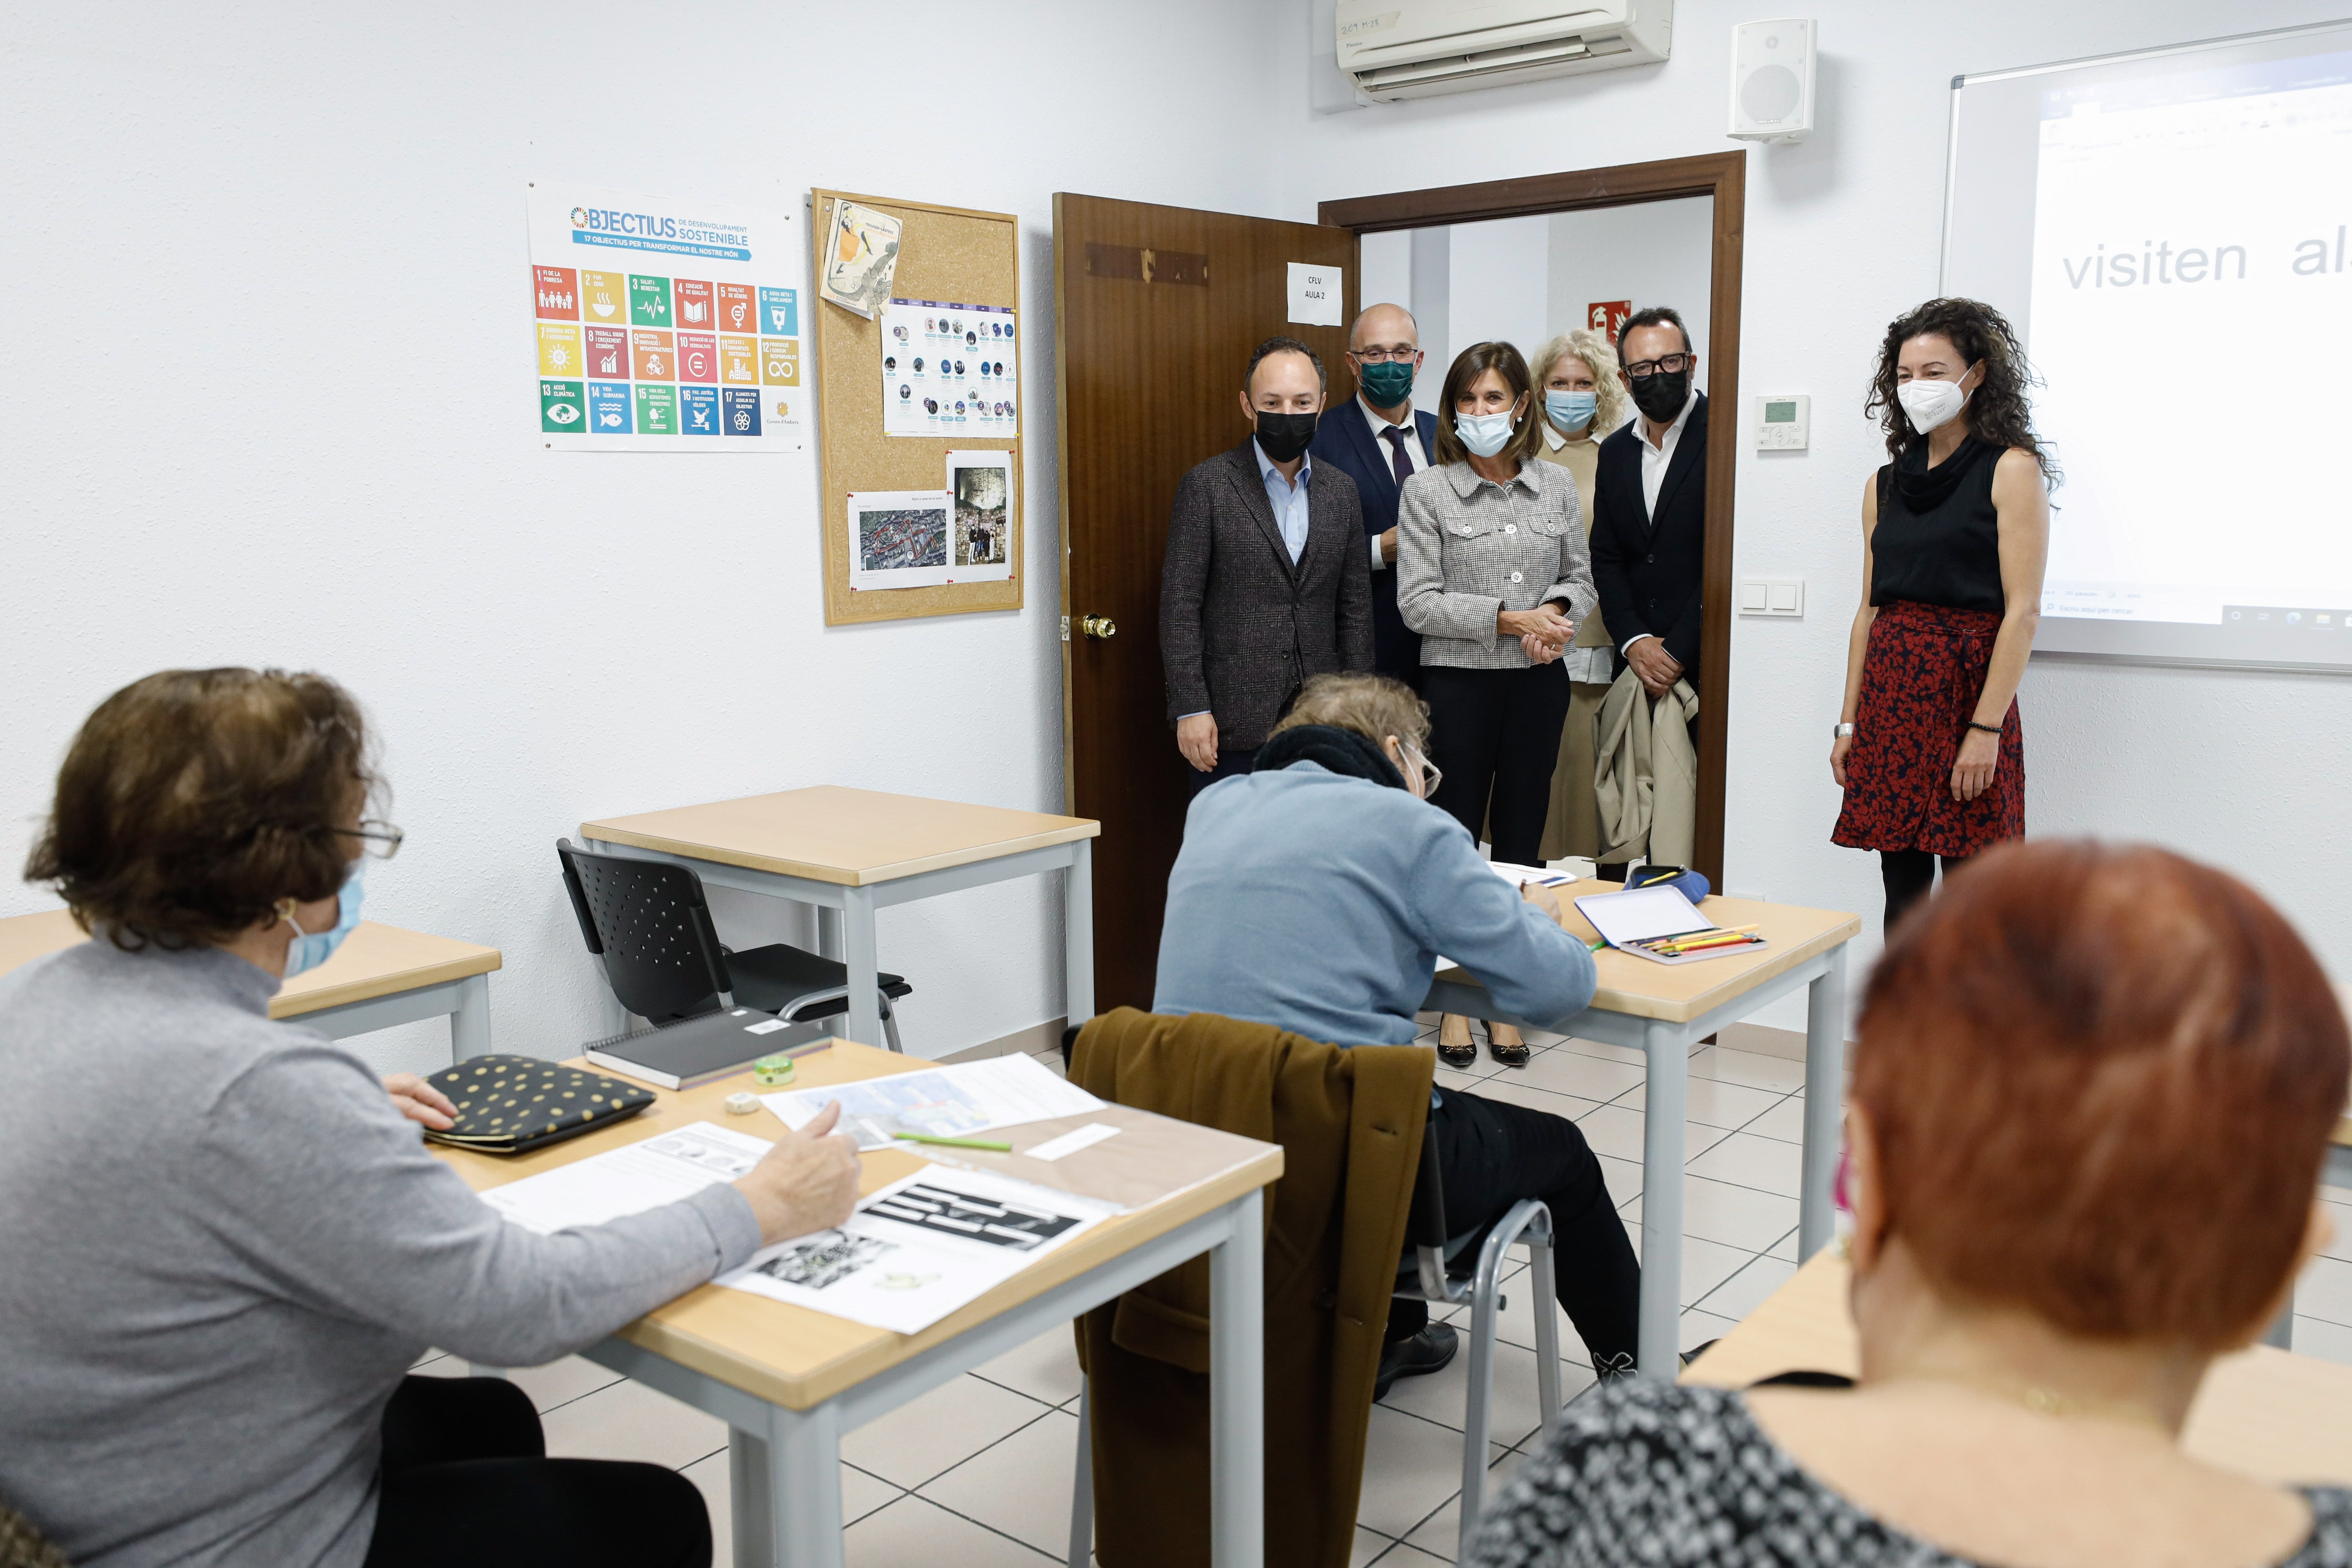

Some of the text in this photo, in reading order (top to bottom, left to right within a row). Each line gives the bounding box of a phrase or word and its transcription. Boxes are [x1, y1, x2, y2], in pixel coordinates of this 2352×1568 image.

[571, 207, 677, 238] OBJECTIUS
[688, 220, 747, 232] DESENVOLUPAMENT
[680, 228, 748, 246] SOSTENIBLE
[592, 236, 628, 246] OBJECTIUS
[642, 241, 690, 252] TRANSFORMAR
[699, 248, 723, 256] NOSTRE
[2062, 224, 2352, 289] visiten al
[537, 269, 541, 281] 1
[585, 274, 590, 286] 2
[633, 279, 638, 289] 3
[678, 282, 683, 293] 4
[721, 287, 726, 297] 5
[762, 290, 767, 301] 6
[1305, 290, 1320, 299] AULA
[540, 327, 545, 338] 7
[588, 330, 593, 341] 8
[634, 333, 639, 344] 9
[680, 336, 688, 347] 10
[721, 339, 728, 350] 11
[762, 342, 769, 352] 12
[542, 384, 551, 396] 13
[591, 386, 600, 398] 14
[638, 388, 646, 399] 15
[683, 390, 691, 401] 16
[726, 391, 733, 402] 17
